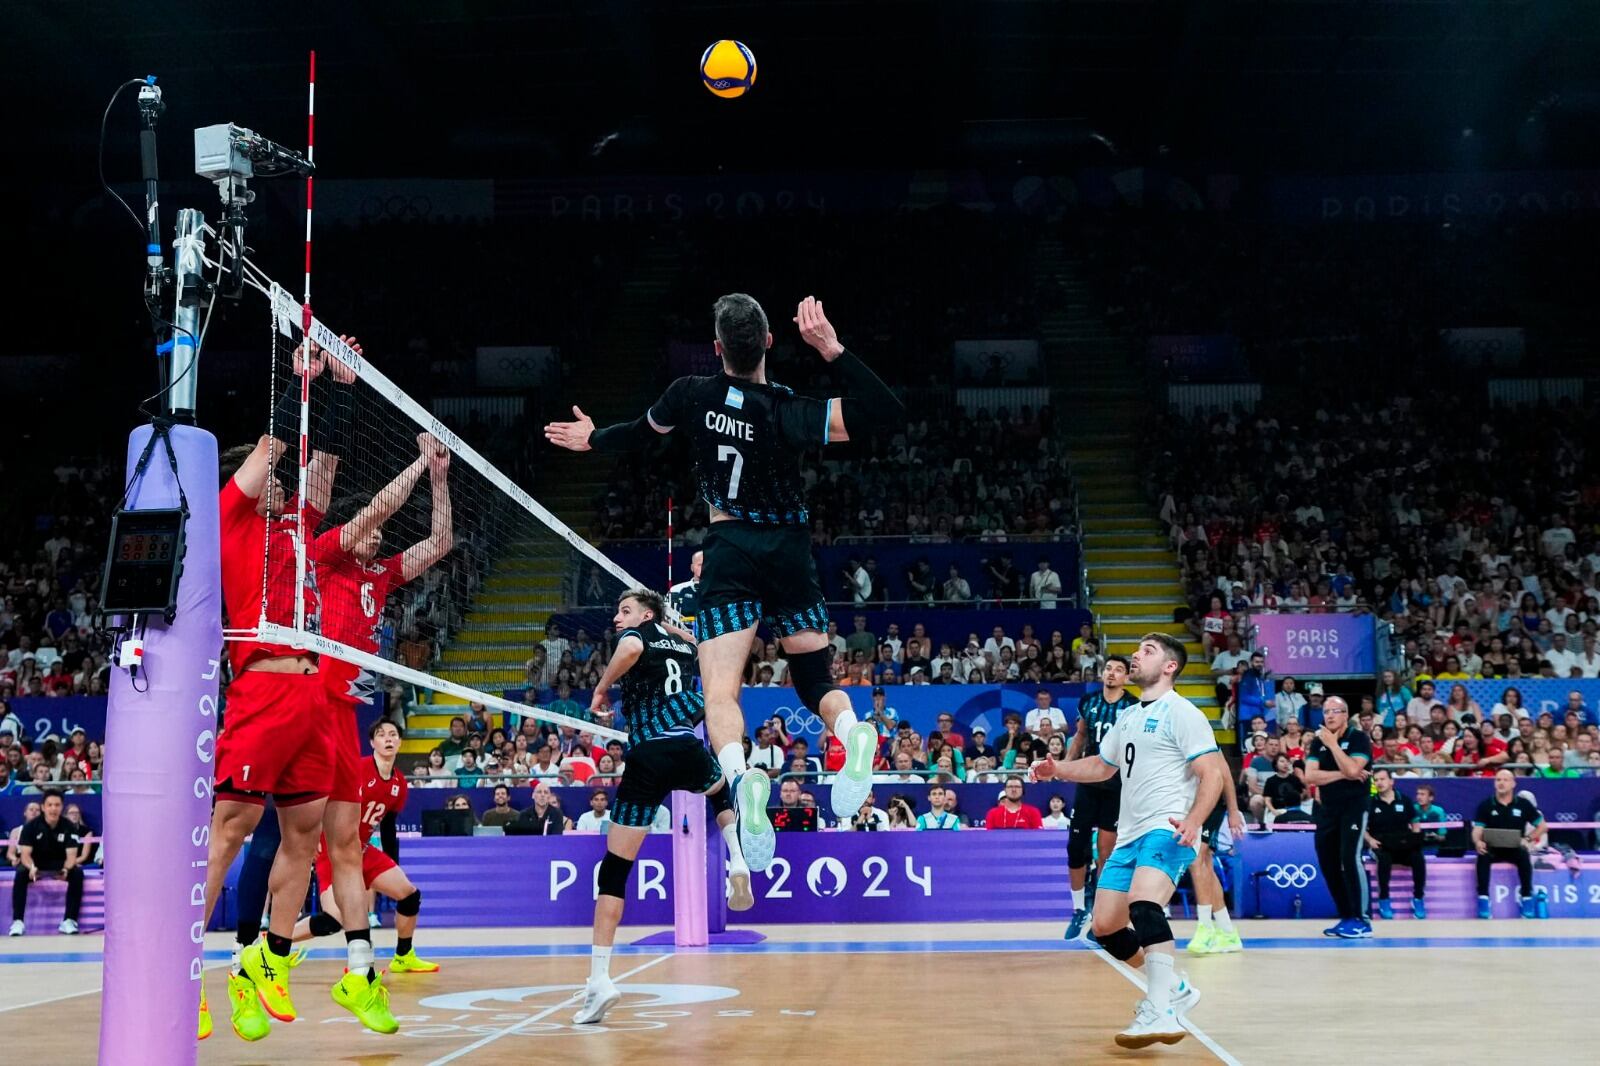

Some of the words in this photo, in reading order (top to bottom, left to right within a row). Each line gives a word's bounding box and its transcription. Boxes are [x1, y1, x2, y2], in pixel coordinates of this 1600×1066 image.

[705, 411, 754, 442] CONTE
[718, 444, 744, 499] 7
[361, 582, 375, 618] 6
[1287, 645, 1340, 659] 2024
[664, 658, 683, 696] 8
[193, 658, 220, 799] 2024
[242, 765, 251, 782] 1
[1125, 742, 1136, 778] 9
[362, 801, 386, 826] 12
[765, 855, 932, 898] 2024
